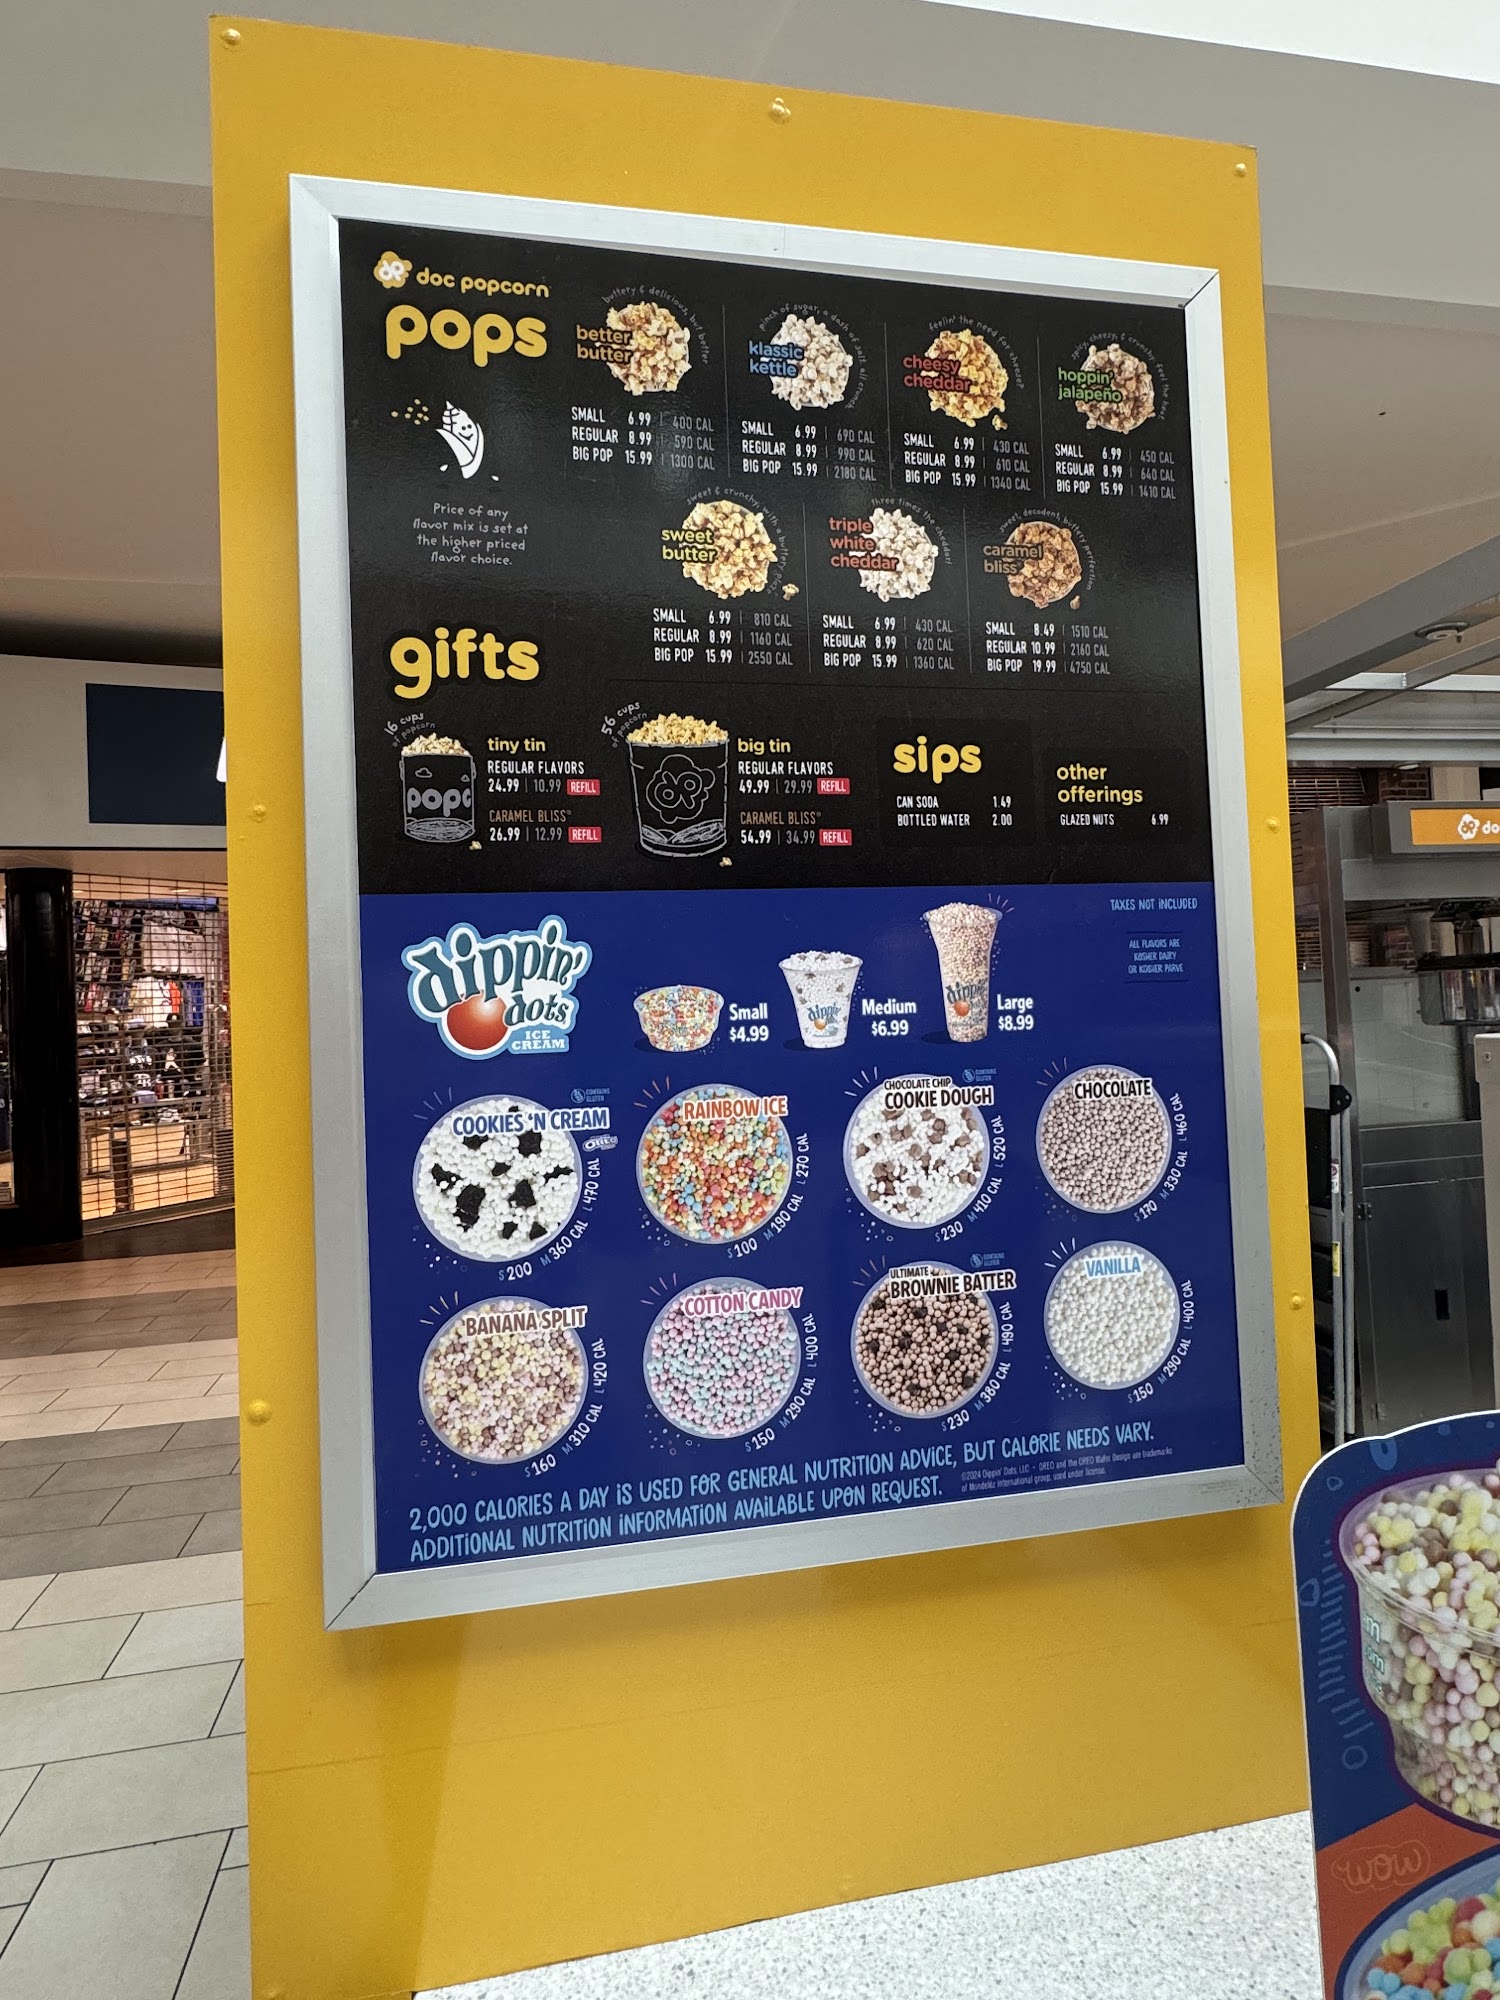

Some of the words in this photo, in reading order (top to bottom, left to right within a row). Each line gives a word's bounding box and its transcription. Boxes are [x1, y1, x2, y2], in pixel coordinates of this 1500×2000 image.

[416, 268, 455, 288] doc
[461, 276, 550, 298] popcorn
[386, 305, 548, 367] pops
[576, 325, 632, 342] better
[577, 344, 632, 364] butter
[748, 341, 803, 360] klassic
[749, 358, 798, 378] kettle
[903, 354, 960, 374] cheesy
[904, 374, 971, 392] cheddar
[1058, 384, 1122, 402] jalapeño
[571, 406, 605, 423] SMALL
[628, 412, 651, 427] 6.99
[673, 416, 693, 430] 400
[696, 417, 714, 432] CAL
[572, 426, 618, 443] REGULAR
[629, 431, 652, 446] 8.99
[674, 435, 693, 448] 590
[696, 436, 715, 451] CAL
[573, 447, 590, 461] BIG
[593, 448, 613, 462] POP
[625, 450, 652, 465] 15.99
[671, 454, 693, 468] 1300
[697, 456, 715, 470] CAL
[433, 502, 465, 516] Price
[470, 504, 484, 517] of
[487, 507, 509, 520] any
[412, 518, 449, 533] flavor
[453, 520, 475, 533] mix
[479, 522, 490, 534] is
[493, 522, 513, 535] set
[516, 523, 528, 535] at
[829, 517, 873, 535] triple
[416, 534, 438, 547] the
[442, 536, 482, 554] higher
[486, 538, 526, 553] priced
[661, 528, 713, 544] sweet
[830, 536, 874, 552] white
[431, 551, 466, 564] flavor
[471, 552, 512, 566] choice.
[662, 546, 717, 562] butter
[983, 542, 1043, 558] caramel
[831, 554, 898, 570] cheddar
[984, 559, 1019, 574] bliss
[822, 614, 854, 630] SMALL
[874, 616, 896, 631] 6.99
[915, 619, 934, 632] 430
[936, 620, 953, 633] CAL
[823, 633, 866, 649] REGULAR
[875, 635, 896, 650] 8.99
[916, 638, 934, 651] 620
[936, 638, 954, 652] CAL
[390, 626, 540, 699] gifts
[824, 653, 841, 667] BIG
[842, 654, 862, 668] POP
[872, 654, 897, 668] 15.99
[914, 656, 934, 669] 1360
[937, 656, 954, 671] CAL
[488, 737, 520, 753] tiny
[524, 738, 545, 751] tin
[737, 738, 764, 756] big
[769, 740, 791, 753] tin
[488, 760, 535, 774] REGULAR
[538, 760, 584, 774] FLAVORS
[737, 761, 785, 774] REGULAR
[788, 761, 834, 775] FLAVORS
[893, 735, 982, 784] sips
[1056, 764, 1107, 780] other
[488, 778, 519, 793] 24.99
[534, 780, 561, 794] 10.99
[570, 782, 596, 793] REFILL
[739, 780, 769, 794] 49.99
[784, 781, 812, 794] 29.99
[820, 781, 846, 792] REFILL
[896, 796, 913, 808] CAN
[916, 796, 938, 808] SODA
[992, 796, 1011, 808] 1.49
[1057, 786, 1143, 805] offerings
[489, 809, 534, 824] CARAMEL
[897, 814, 937, 827] BOTTLED
[940, 814, 970, 827] WATER
[992, 814, 1012, 826] 2.00
[1060, 814, 1090, 825] GLAZED
[1093, 814, 1114, 825] NUTS
[1152, 814, 1169, 825] 6.99
[490, 827, 520, 842] 26.99
[535, 828, 562, 842] 12.99
[572, 829, 598, 841] REFILL
[1110, 899, 1135, 911] TAXES
[1138, 899, 1154, 910] NOT
[504, 994, 570, 1026] dots
[729, 1003, 768, 1020] Small
[862, 998, 917, 1015] Medium
[997, 994, 1034, 1012] Large
[871, 1020, 909, 1036] $6.99
[998, 1015, 1034, 1031] $8.99
[525, 1030, 550, 1040] ICE
[729, 1025, 769, 1043] $4.99
[512, 1038, 566, 1050] CREAM
[884, 1079, 930, 1089] CHOCOLATE
[931, 1078, 951, 1088] CHIP
[1075, 1079, 1151, 1099] CHOCOLATE
[885, 1089, 938, 1110] COOKIE
[941, 1088, 992, 1106] DOUGH
[684, 1100, 761, 1120] RAINBOW
[764, 1098, 788, 1116] ICE
[453, 1112, 524, 1135] COOKIES
[550, 1109, 608, 1130] CREAM
[586, 1158, 599, 1179] CAL
[584, 1181, 599, 1205] 470
[569, 1220, 588, 1241] CAL
[548, 1235, 573, 1260] 360
[506, 1263, 533, 1281] 200
[890, 1267, 929, 1278] ULTIMATE
[1085, 1258, 1142, 1276] VANILLA
[891, 1275, 960, 1299] BROWNIE
[963, 1271, 1014, 1293] BATTER
[684, 1293, 747, 1317] COTTON
[749, 1289, 802, 1309] CANDY
[466, 1313, 538, 1336] BANANA
[541, 1308, 586, 1330] SPLIT
[410, 1503, 467, 1532] 2,000
[475, 1494, 553, 1523] CALORIES
[560, 1494, 572, 1511] A
[580, 1487, 609, 1511] DAY
[639, 1477, 684, 1503] USED
[690, 1472, 721, 1495] FOR
[727, 1464, 798, 1491] GENERAL
[963, 1440, 995, 1463] BUT
[1001, 1433, 1061, 1458] CALORIE
[1067, 1426, 1110, 1451] NEEDS
[1115, 1421, 1154, 1444] VARY.
[821, 1485, 865, 1510] UPON
[872, 1476, 942, 1504] REQUEST.
